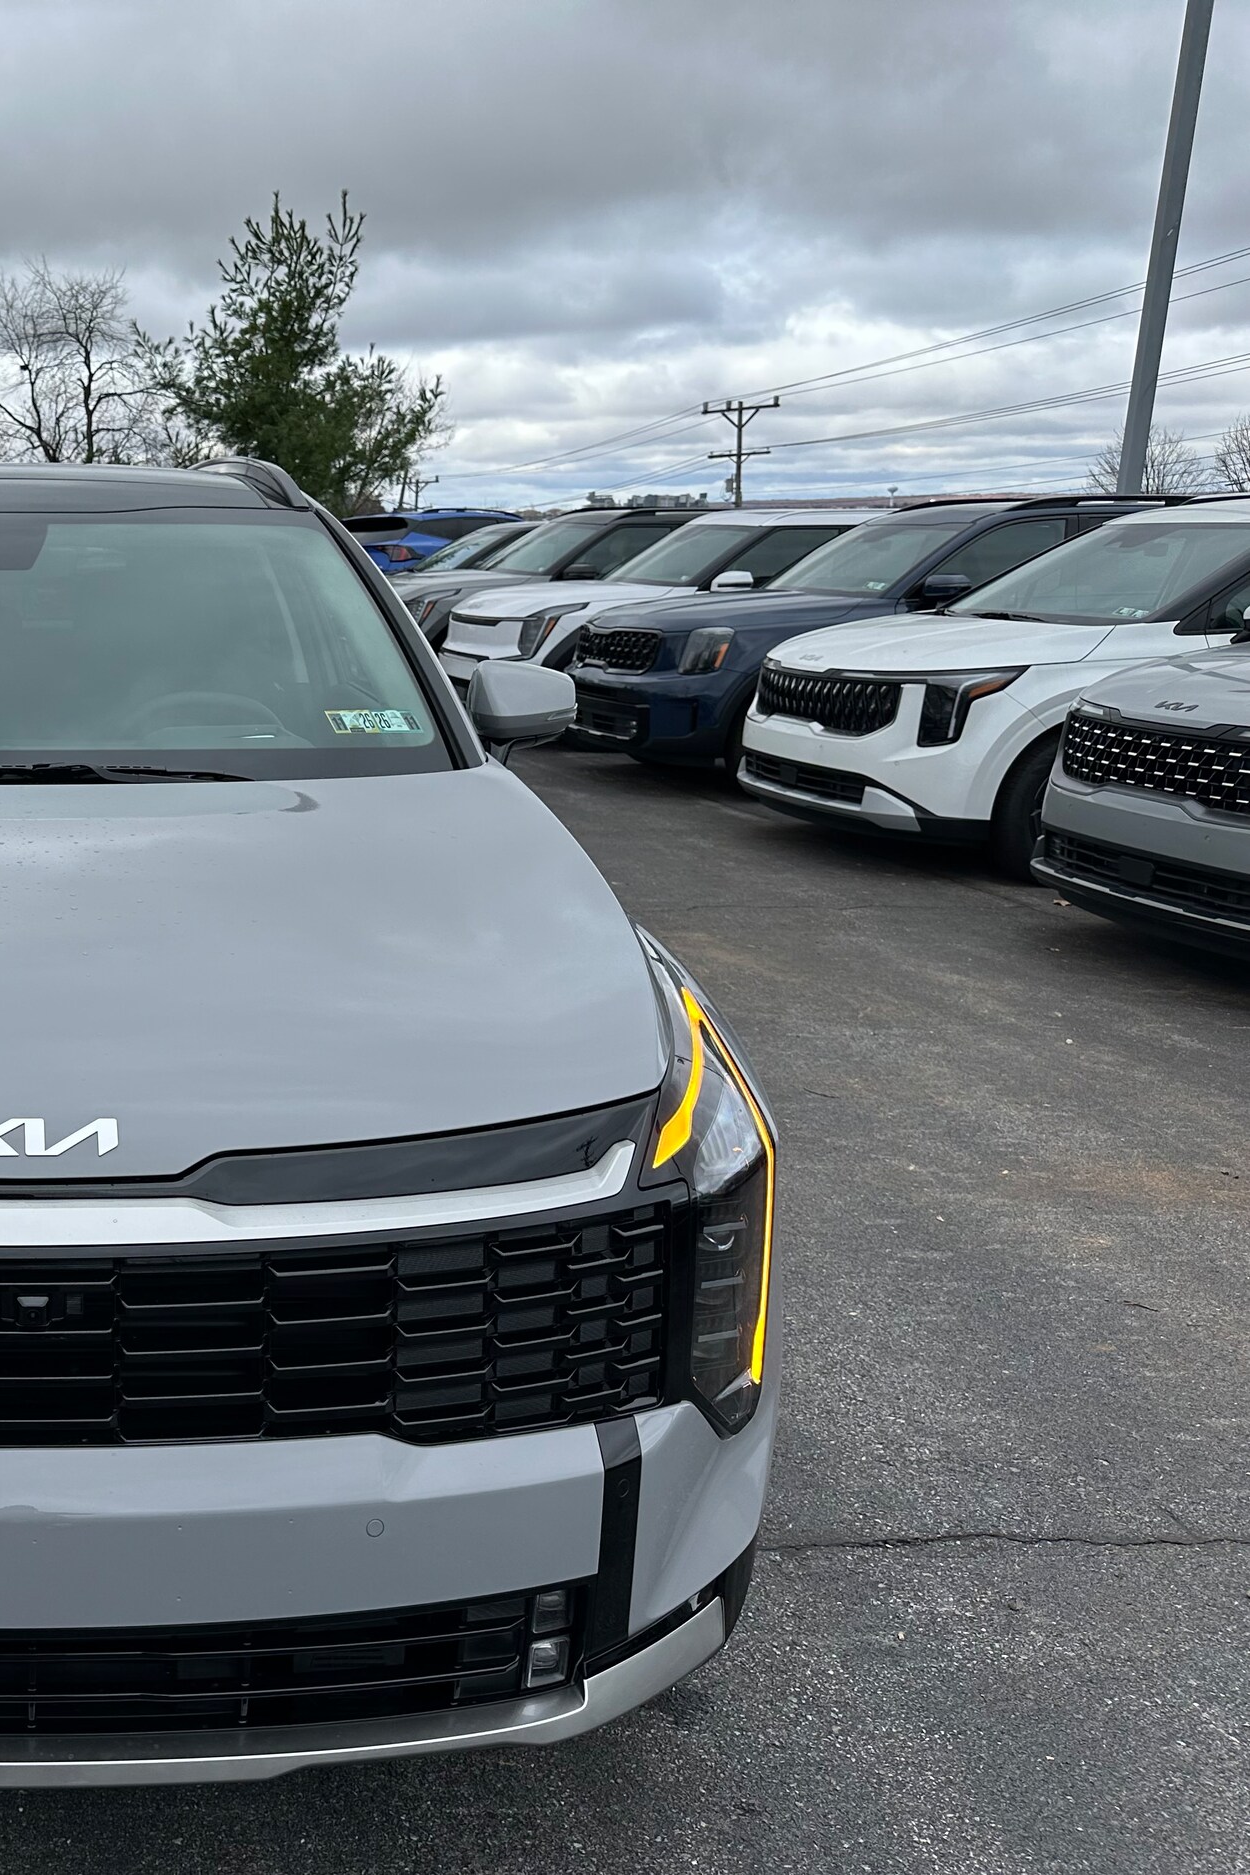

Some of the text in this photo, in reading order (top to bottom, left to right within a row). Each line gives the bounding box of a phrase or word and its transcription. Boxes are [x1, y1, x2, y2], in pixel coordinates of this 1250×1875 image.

[1154, 700, 1199, 712] KIA
[359, 712, 375, 729] 26
[374, 712, 392, 729] 26
